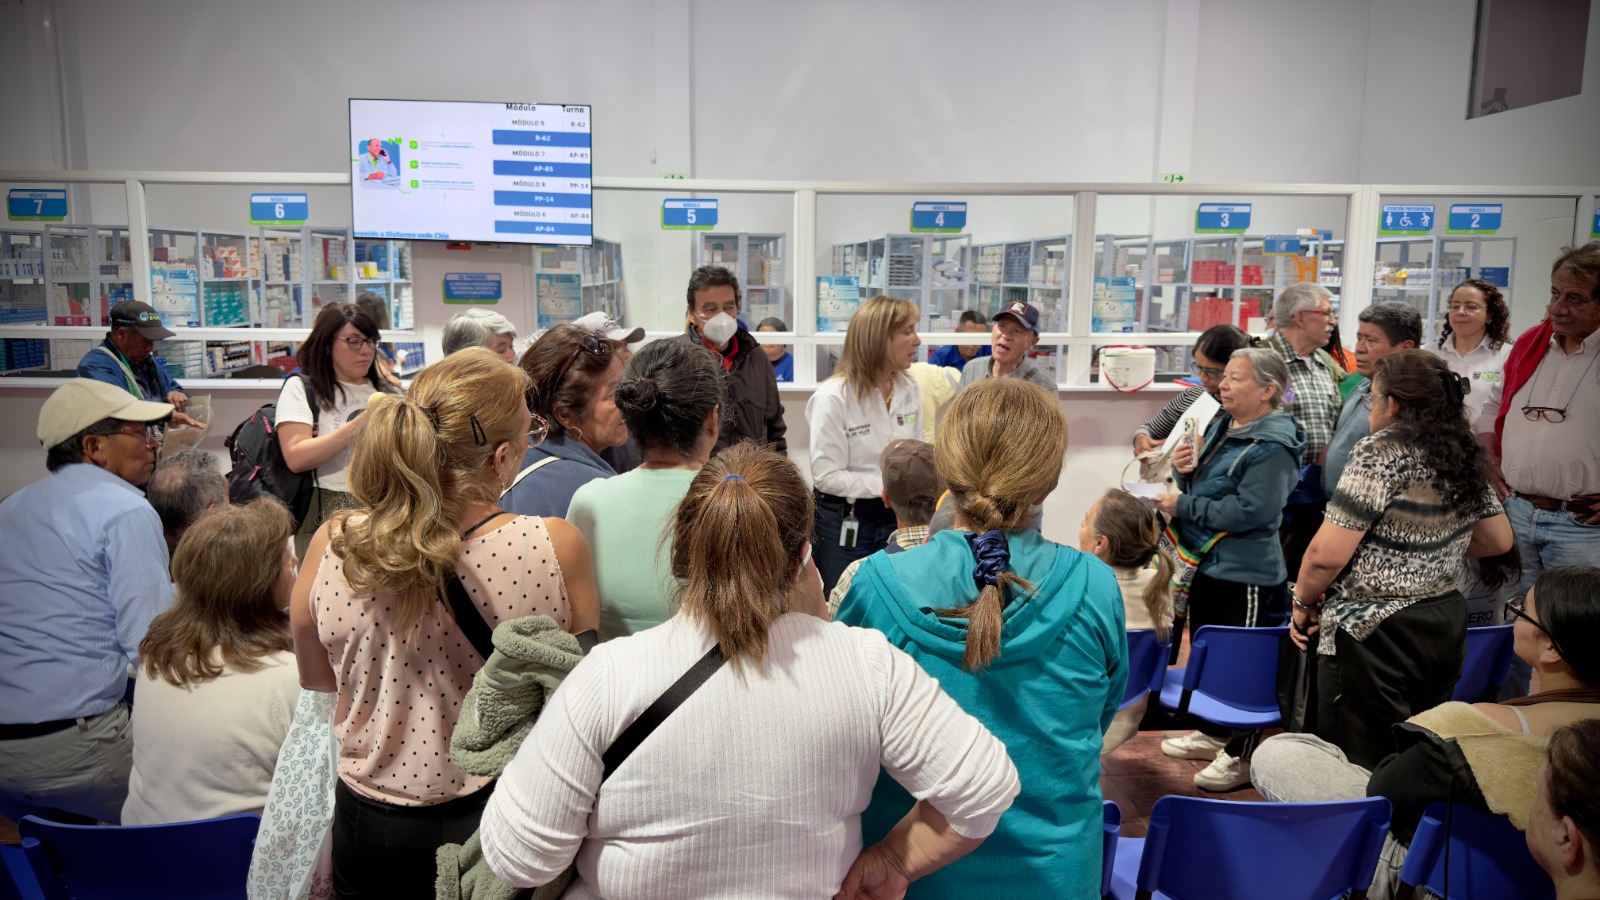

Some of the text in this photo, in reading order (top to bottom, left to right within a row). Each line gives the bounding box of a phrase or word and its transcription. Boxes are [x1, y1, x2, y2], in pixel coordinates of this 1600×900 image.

[562, 105, 585, 113] Turno
[512, 119, 539, 127] MÓDULO
[535, 134, 551, 142] R-62
[512, 149, 540, 157] MÓDULO
[513, 179, 540, 187] MÓDULO
[34, 199, 43, 215] 7
[275, 203, 285, 219] 6
[513, 209, 541, 217] MÓDULO
[687, 209, 697, 224] 5
[935, 212, 945, 226] 4
[1220, 212, 1229, 228] 3
[1471, 214, 1480, 228] 2
